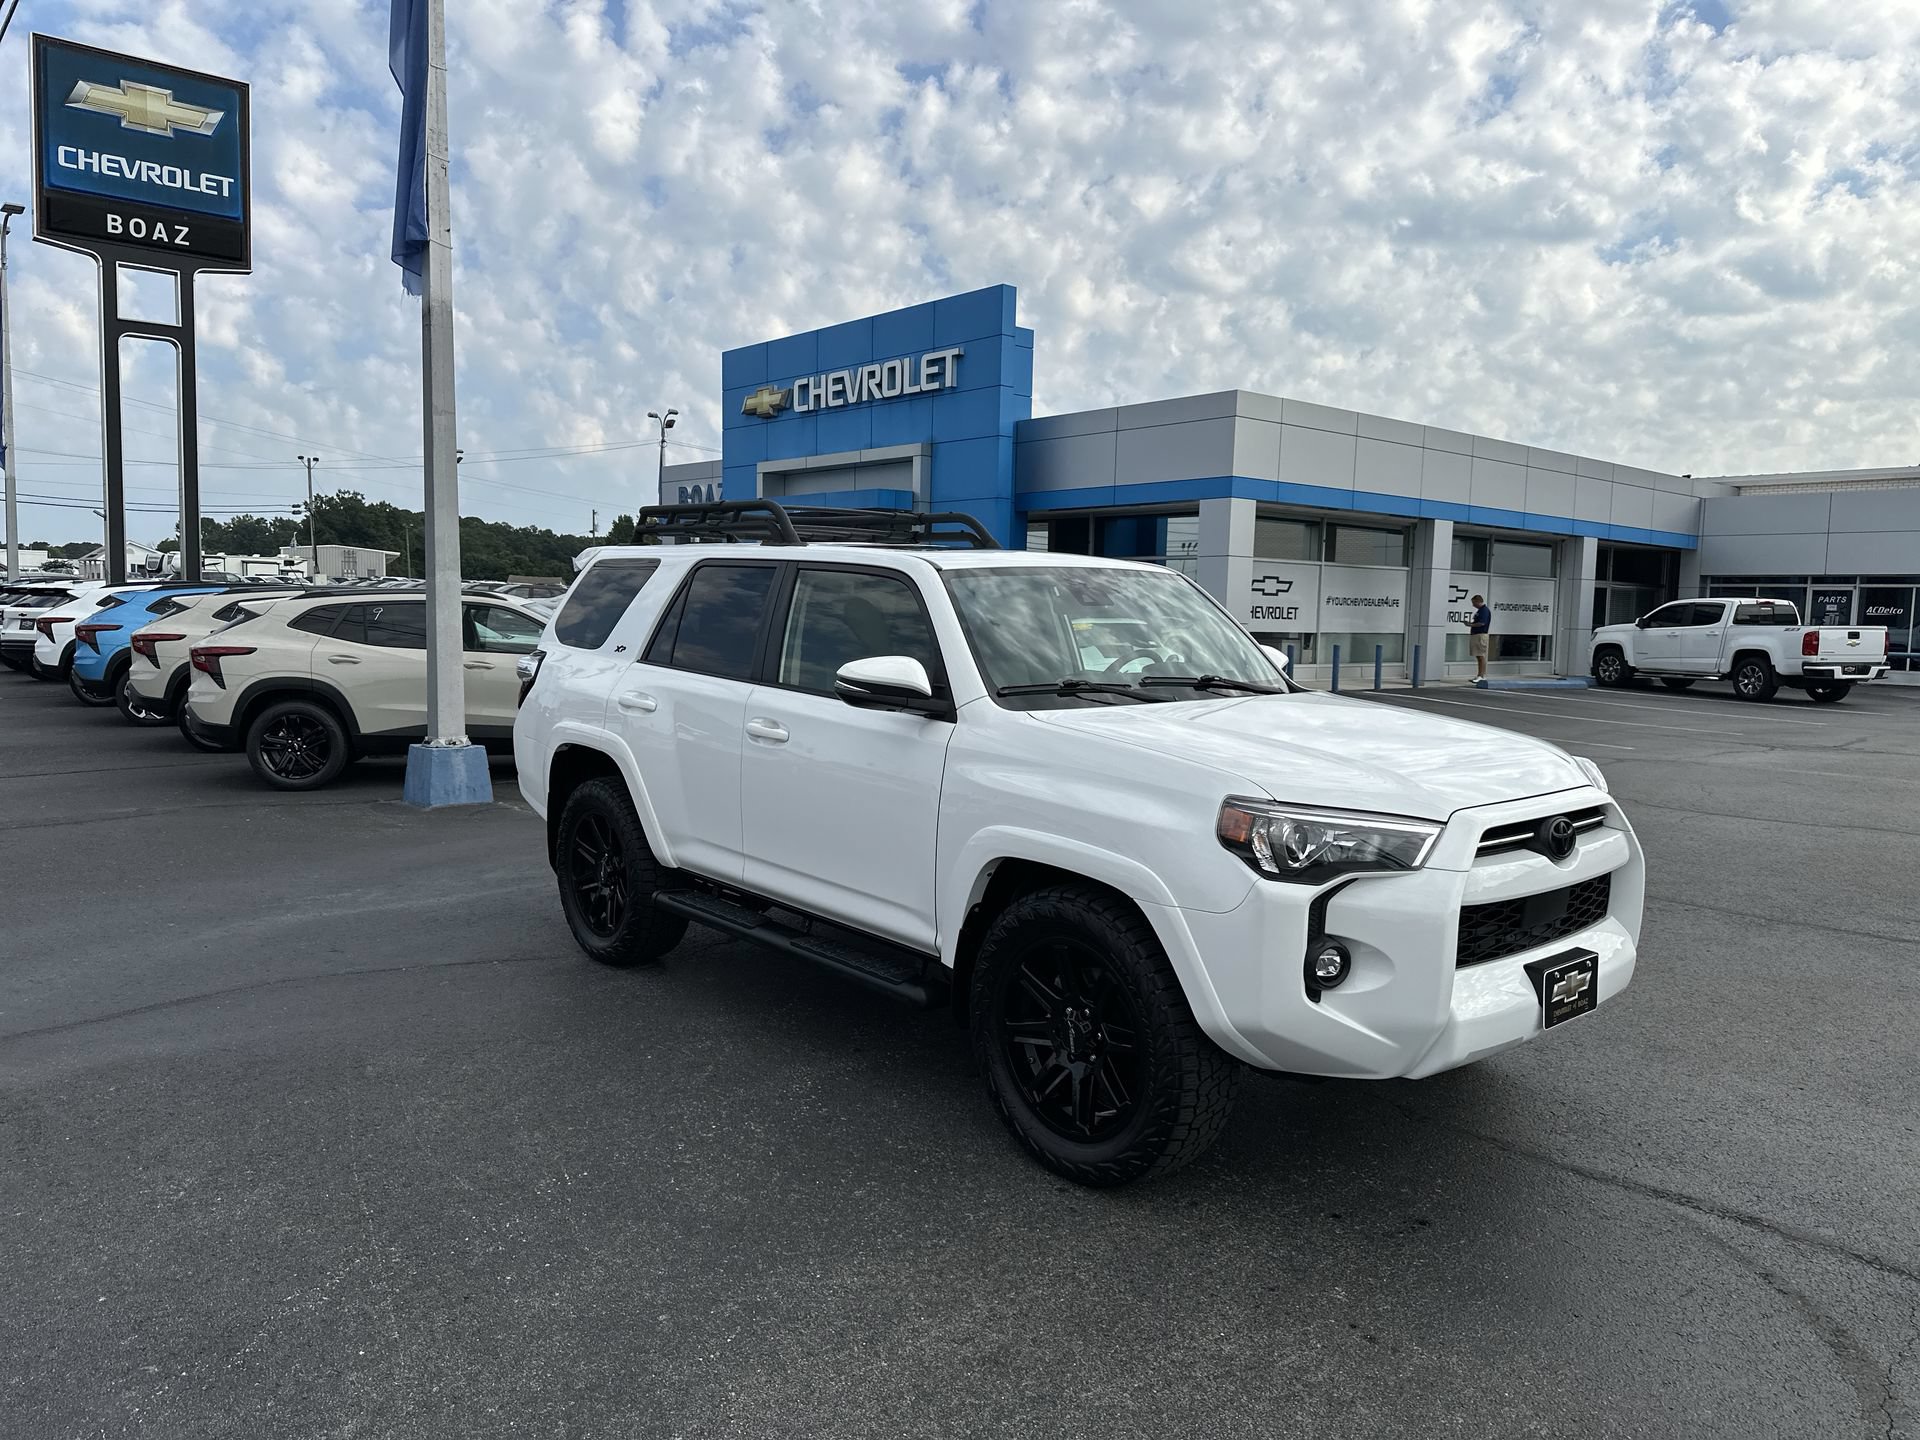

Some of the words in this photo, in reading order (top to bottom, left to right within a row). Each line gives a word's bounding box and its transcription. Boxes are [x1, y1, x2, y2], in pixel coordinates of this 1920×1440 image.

[57, 145, 235, 197] CHEVROLET
[106, 213, 190, 246] BOAZ
[793, 347, 964, 413] CHEVROLET
[1866, 606, 1904, 615] ACDelco
